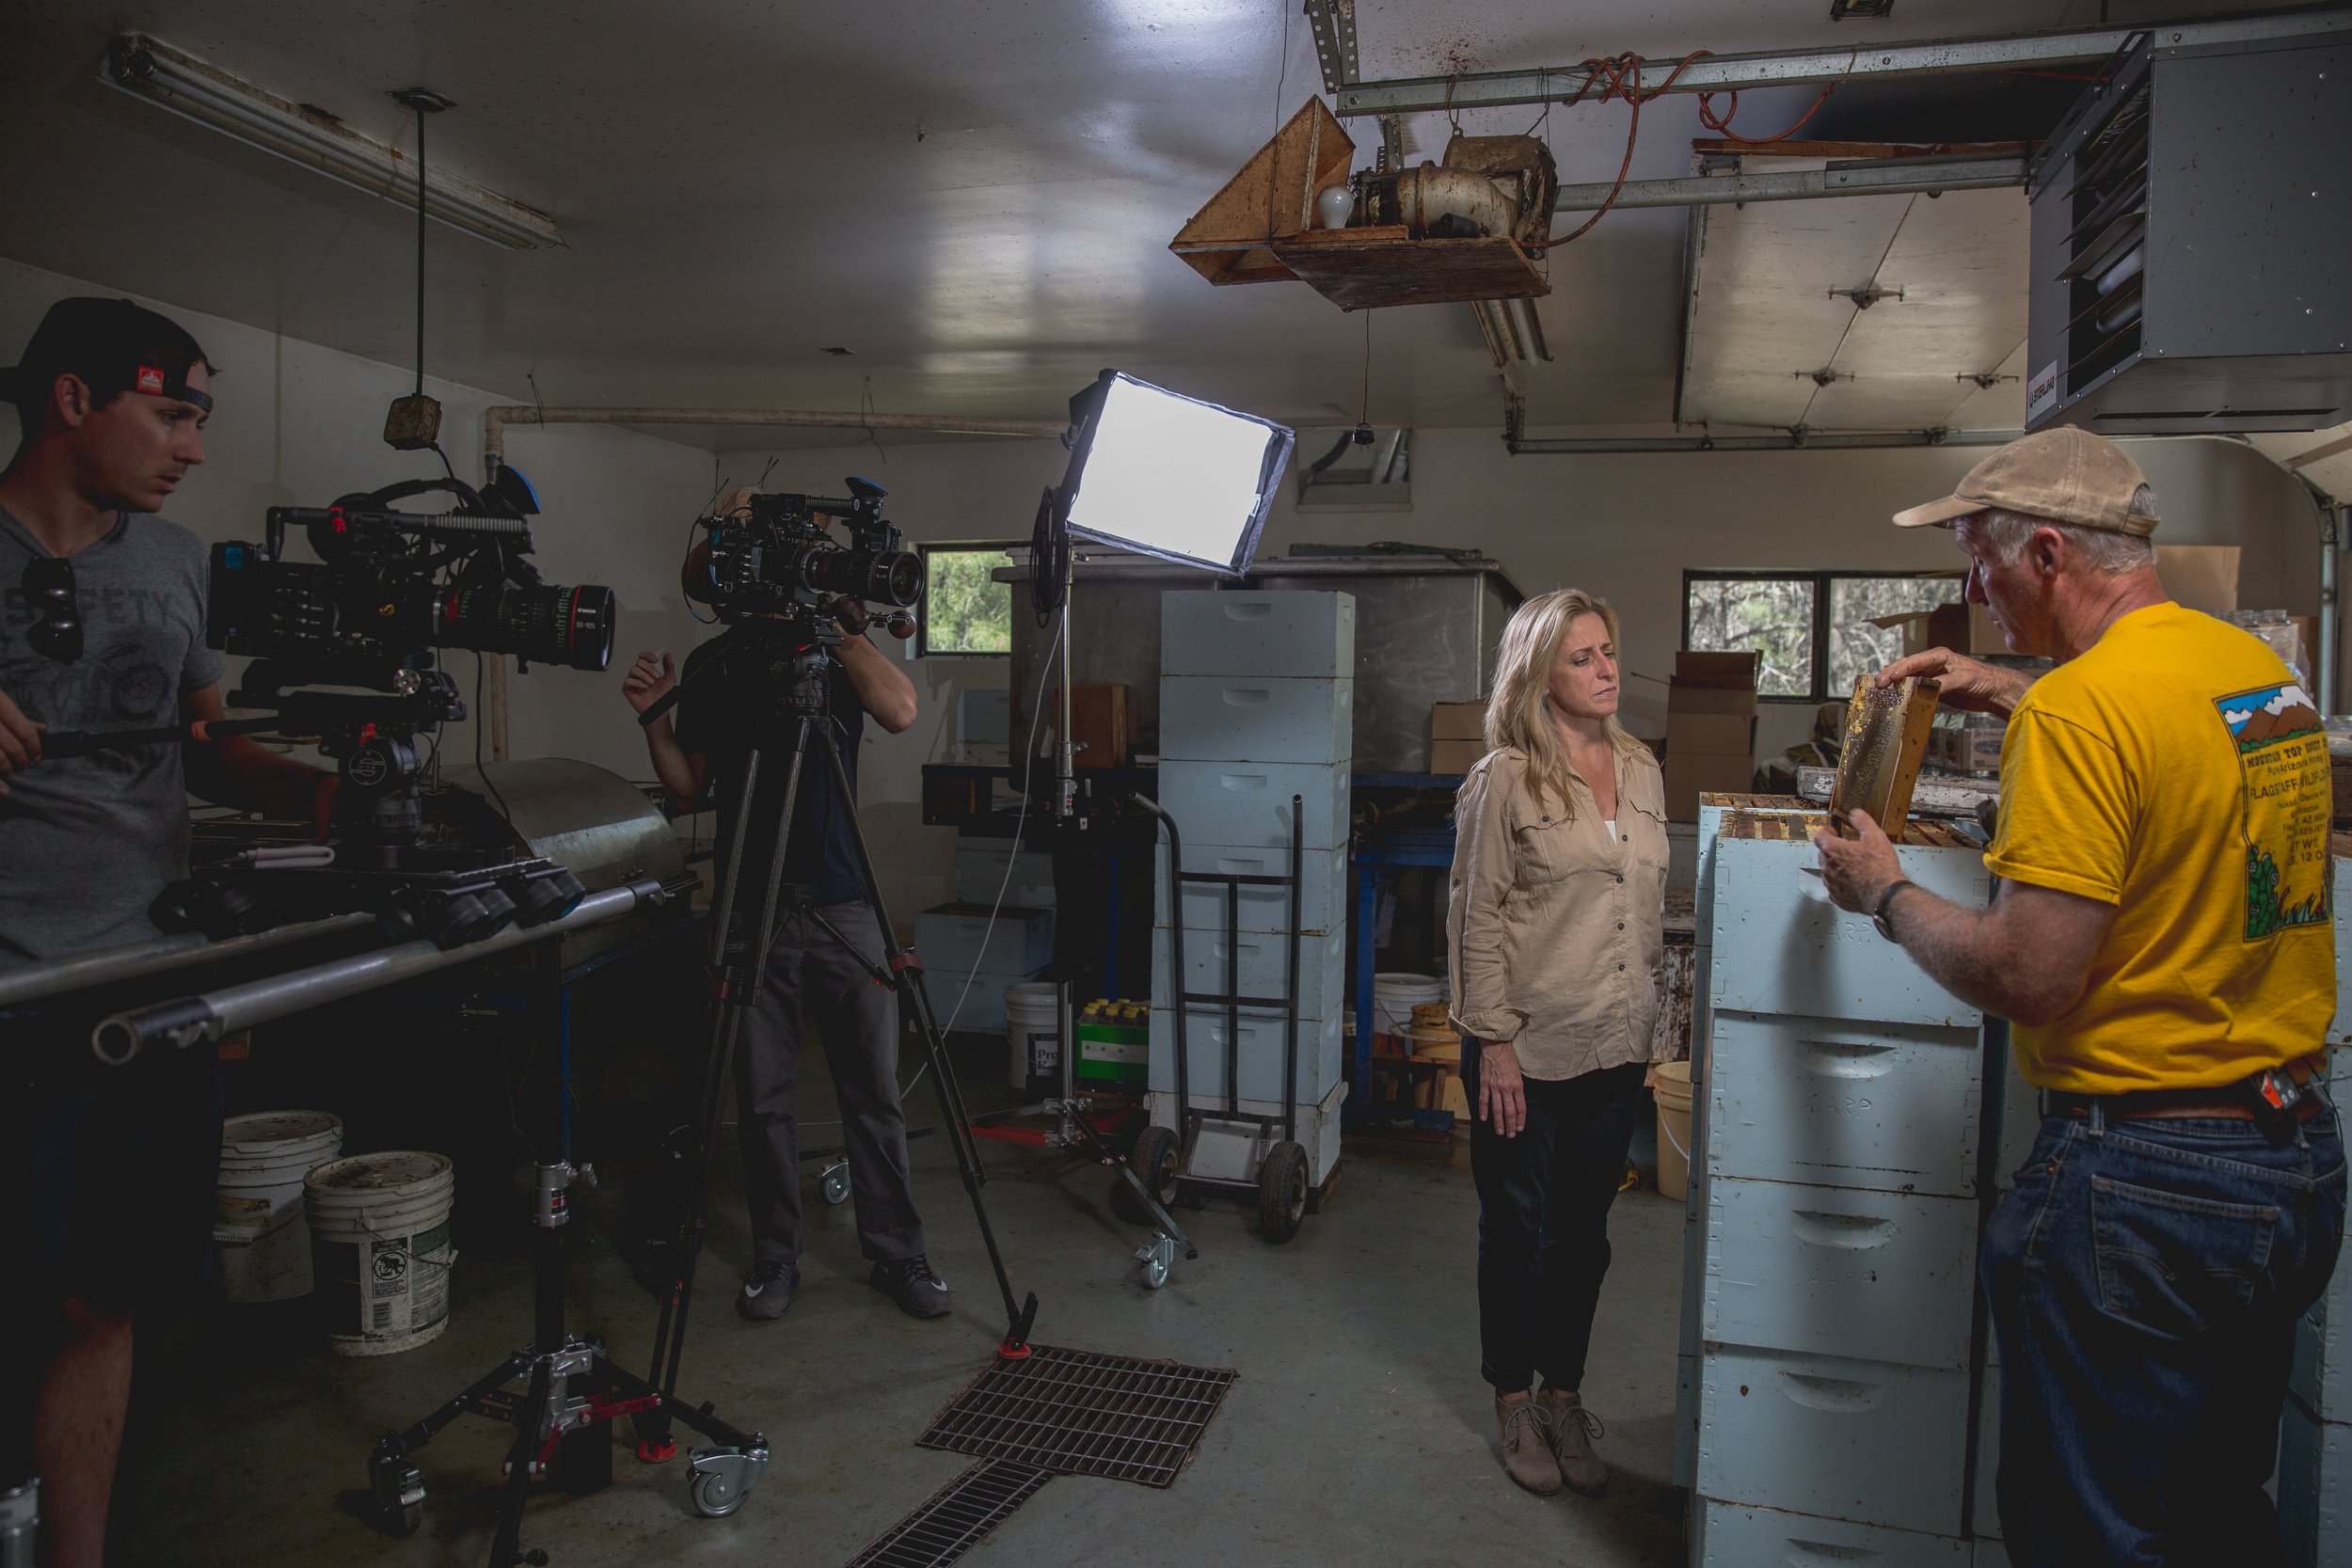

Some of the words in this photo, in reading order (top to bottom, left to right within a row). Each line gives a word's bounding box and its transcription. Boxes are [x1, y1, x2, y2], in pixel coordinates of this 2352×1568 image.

[5, 587, 171, 626] SFETY
[2284, 746, 2302, 758] TOP
[2301, 851, 2312, 862] 12
[2315, 848, 2326, 861] O
